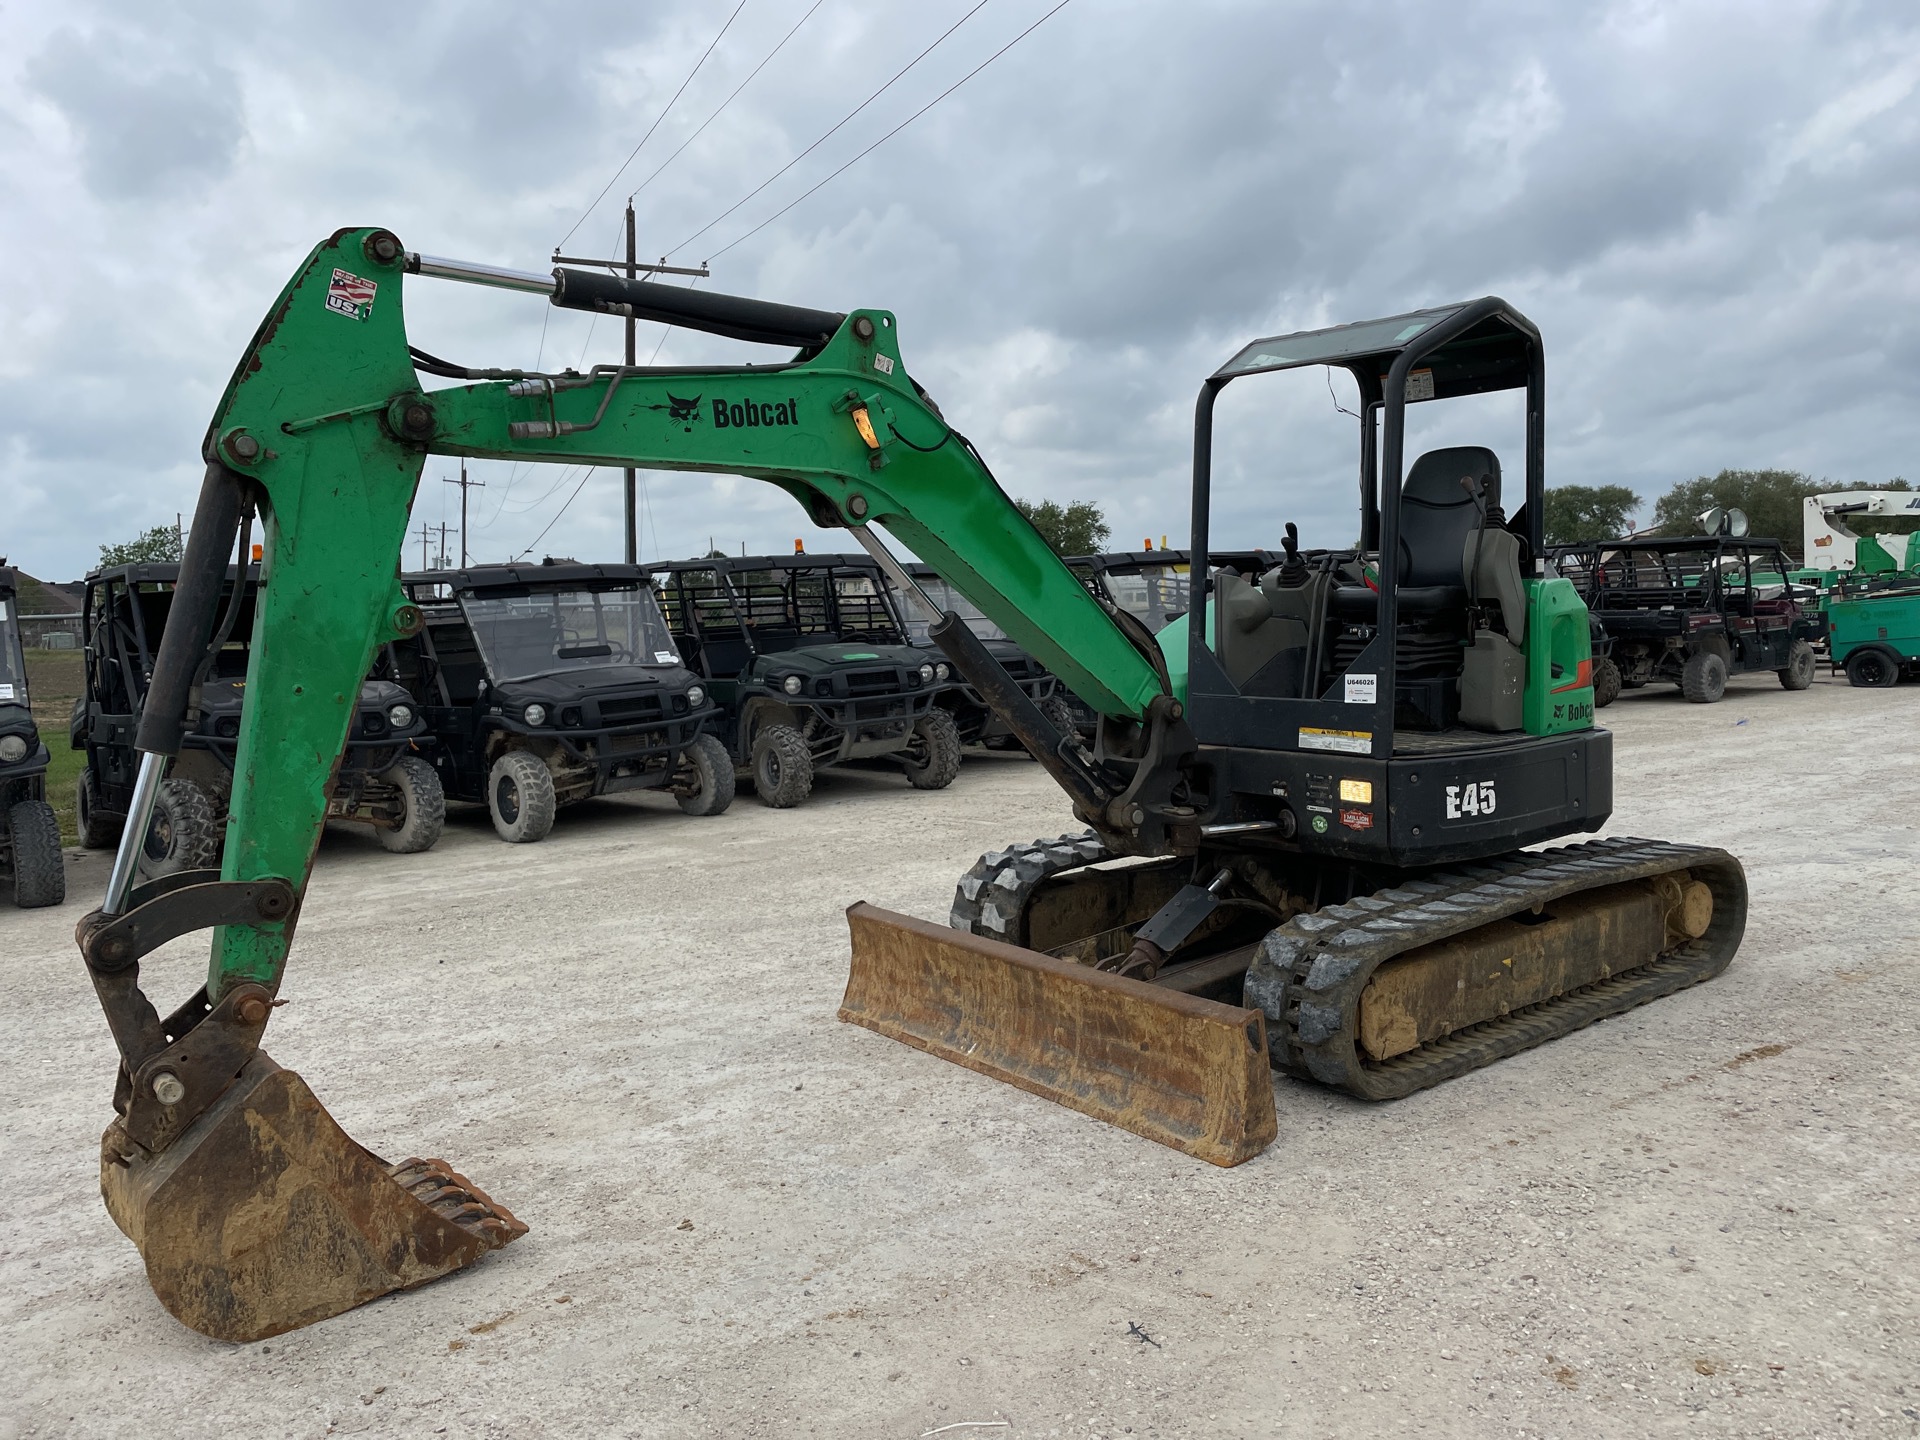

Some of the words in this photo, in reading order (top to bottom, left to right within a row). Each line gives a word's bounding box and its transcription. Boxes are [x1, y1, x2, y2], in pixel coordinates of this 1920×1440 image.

[711, 398, 798, 428] Bobcat
[1568, 702, 1593, 721] Bobca
[1446, 780, 1496, 819] E45
[1346, 814, 1369, 822] MILLION
